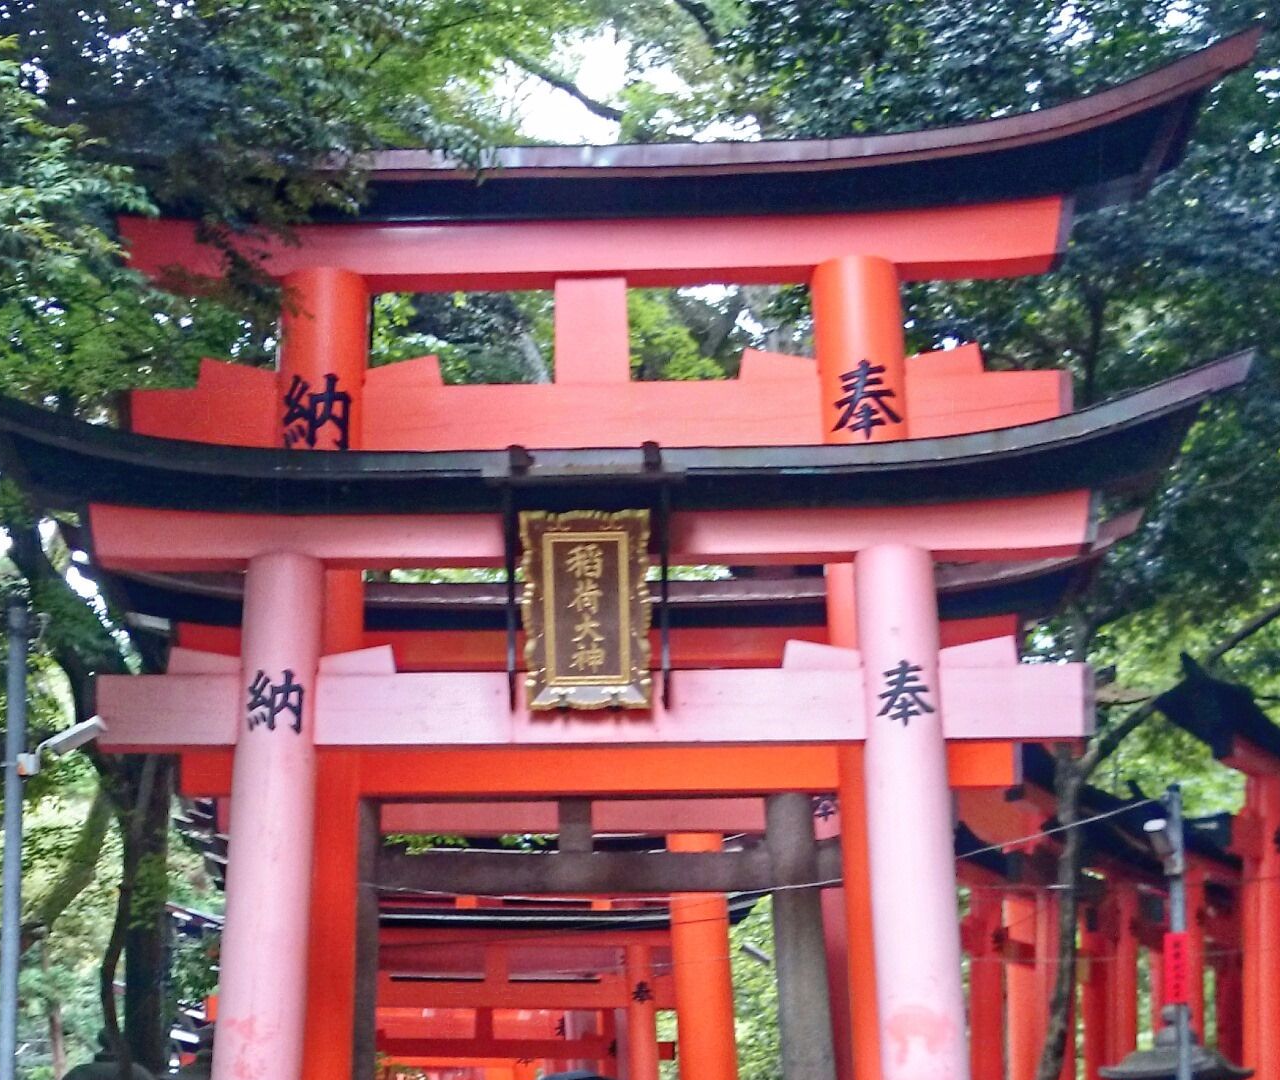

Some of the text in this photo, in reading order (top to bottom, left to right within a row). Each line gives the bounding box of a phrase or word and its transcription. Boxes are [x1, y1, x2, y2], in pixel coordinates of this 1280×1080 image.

[282, 374, 352, 449] 納
[831, 359, 903, 440] 奉
[246, 669, 304, 735] 納
[876, 660, 935, 727] 奉
